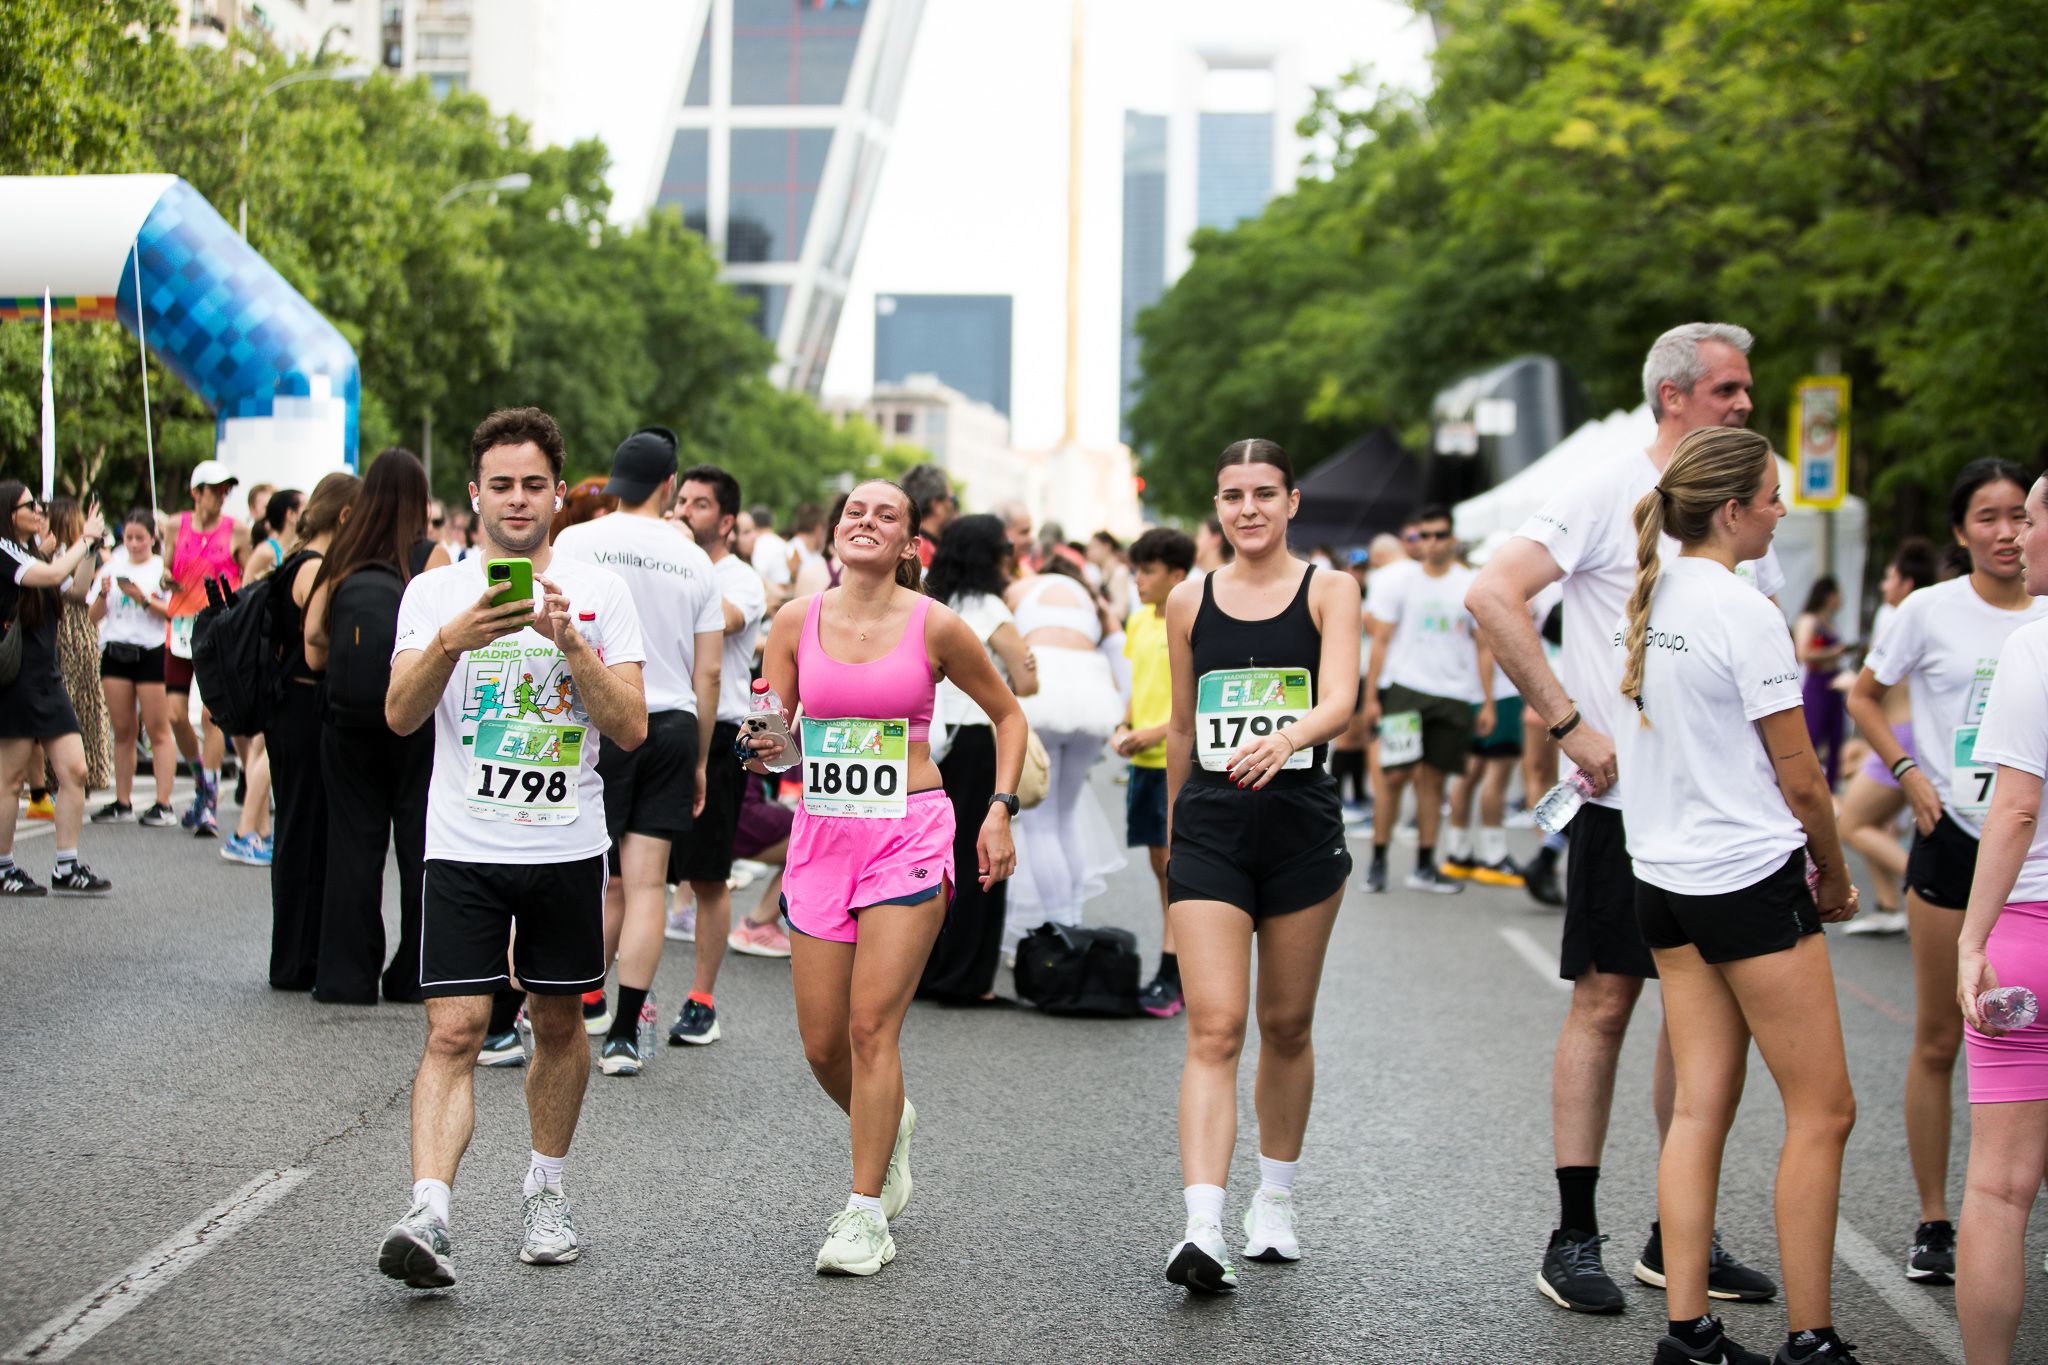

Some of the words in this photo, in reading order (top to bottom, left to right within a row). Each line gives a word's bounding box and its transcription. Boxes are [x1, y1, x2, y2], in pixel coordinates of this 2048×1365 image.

[469, 649, 521, 660] MADRID
[524, 647, 553, 658] CON
[556, 649, 567, 659] L
[491, 640, 519, 648] arrera
[1223, 673, 1252, 681] MADRID
[1253, 672, 1268, 680] CON
[1221, 680, 1285, 708] ELA
[533, 726, 548, 734] CON
[822, 726, 882, 755] ELA
[496, 730, 560, 762] ELA
[478, 764, 567, 803] 1798
[809, 762, 897, 797] 1800
